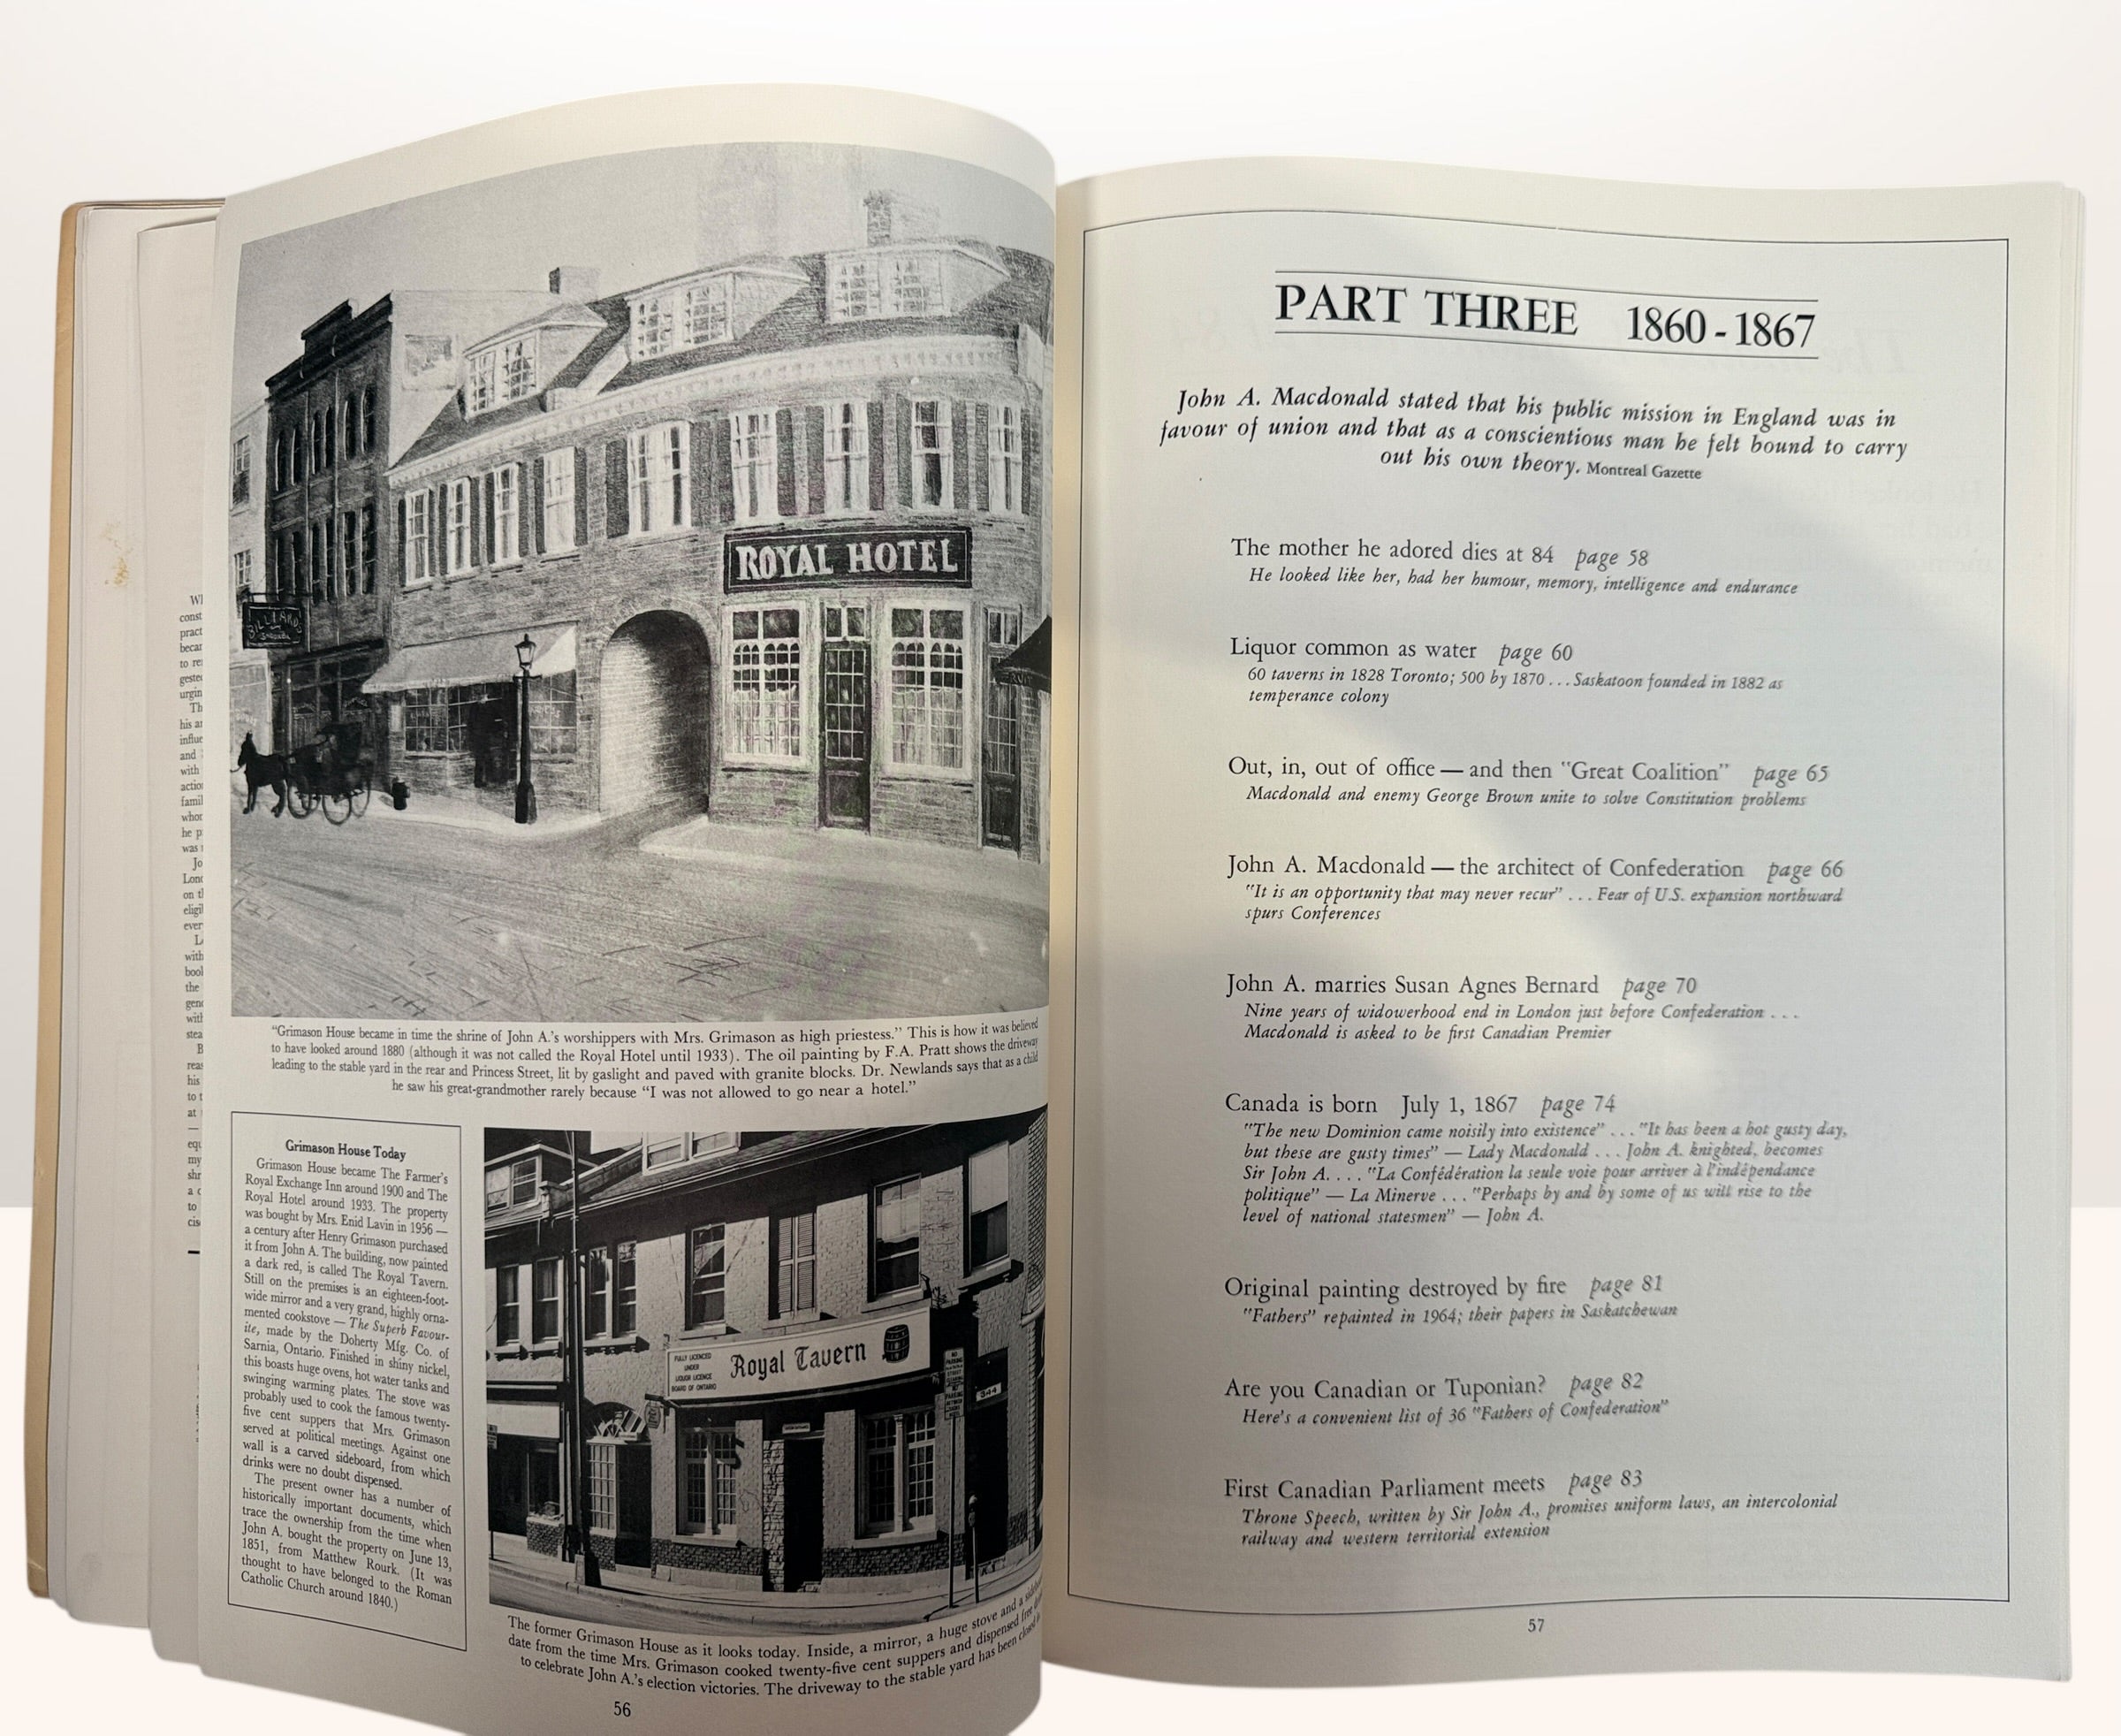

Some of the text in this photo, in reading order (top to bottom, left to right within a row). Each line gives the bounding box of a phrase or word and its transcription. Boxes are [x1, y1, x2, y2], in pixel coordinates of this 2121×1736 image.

[1275, 285, 1407, 323] PART
[1424, 289, 1578, 335] THREE
[1177, 386, 1896, 433] John A. Macdonald stated that his public mission in England was in
[1159, 415, 1907, 462] favour of union and that as a conscientious man he felt bound to carry
[1380, 446, 1702, 480] out his own theory. Montreal Gazette
[736, 538, 958, 580] ROYAL HOTEL
[1231, 537, 1649, 572] The mother he adored dies at 84 page 58
[1249, 567, 1798, 596] He looked like her, had her humour, memory, intelligence and endurance
[247, 611, 302, 639] BILLIARDS
[1230, 637, 1573, 667] Liquor common as water page 60
[180, 719, 192, 729] his
[180, 750, 196, 760] and
[180, 764, 200, 776] with
[186, 981, 199, 992] the
[326, 1026, 355, 1038] House
[359, 1027, 394, 1039] became
[411, 1031, 433, 1040] time
[437, 1029, 452, 1040] the
[457, 1029, 487, 1041] shrine
[491, 1030, 502, 1042] of
[506, 1030, 533, 1046] John
[564, 1031, 635, 1047] worshippers
[641, 1031, 668, 1043] with
[674, 1032, 703, 1043] Mrs.
[710, 1031, 775, 1043] Grimason
[800, 1029, 831, 1046] high
[907, 1025, 937, 1039] This
[940, 1025, 949, 1037] is
[954, 1024, 977, 1037] how
[981, 1023, 988, 1035] it
[1012, 1016, 1038, 1032] believed
[187, 1075, 200, 1085] his
[285, 1139, 406, 1162] Grimason House Today
[256, 1157, 302, 1172] Grimason
[308, 1161, 337, 1175] House
[341, 1163, 376, 1178] became
[381, 1167, 400, 1180] The
[730, 1343, 866, 1381] Royal Tavern
[980, 1387, 997, 1397] 344
[1224, 1372, 1644, 1405] Are you Canadian or Tuponian? page 82
[1224, 1469, 1642, 1500] First Canadian Parliament meets page 83
[507, 1597, 1023, 1662] The former Grimason House as it looks today. Inside, a mirror, a huge stove and a
[1528, 1618, 1545, 1633] 57
[614, 1701, 631, 1717] 56
